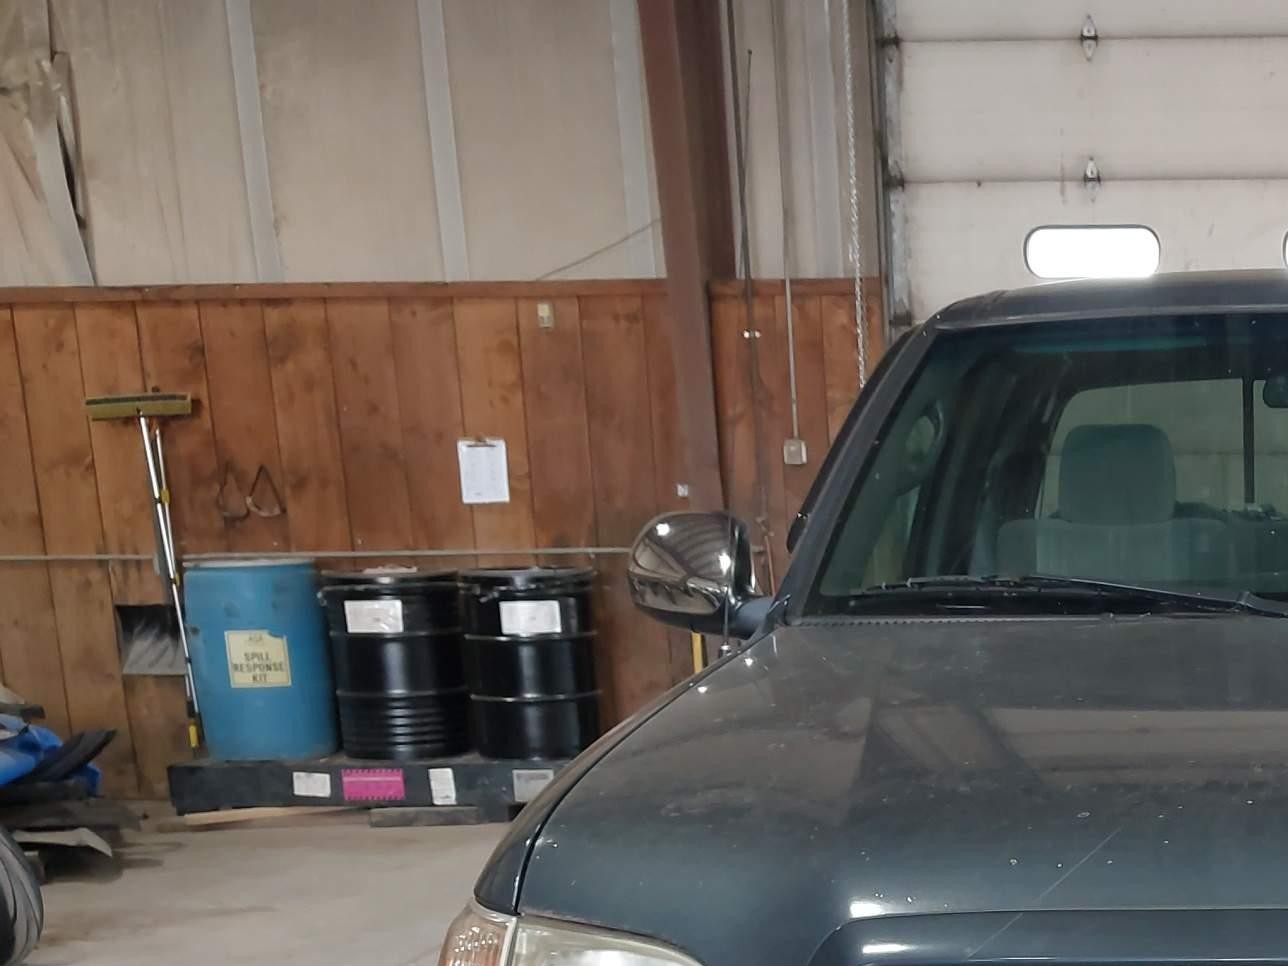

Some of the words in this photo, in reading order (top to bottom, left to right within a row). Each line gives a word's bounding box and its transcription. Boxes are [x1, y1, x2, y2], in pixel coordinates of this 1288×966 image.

[244, 652, 269, 661] SPILL
[232, 662, 285, 673] RESPONSE
[252, 673, 268, 683] KIT
